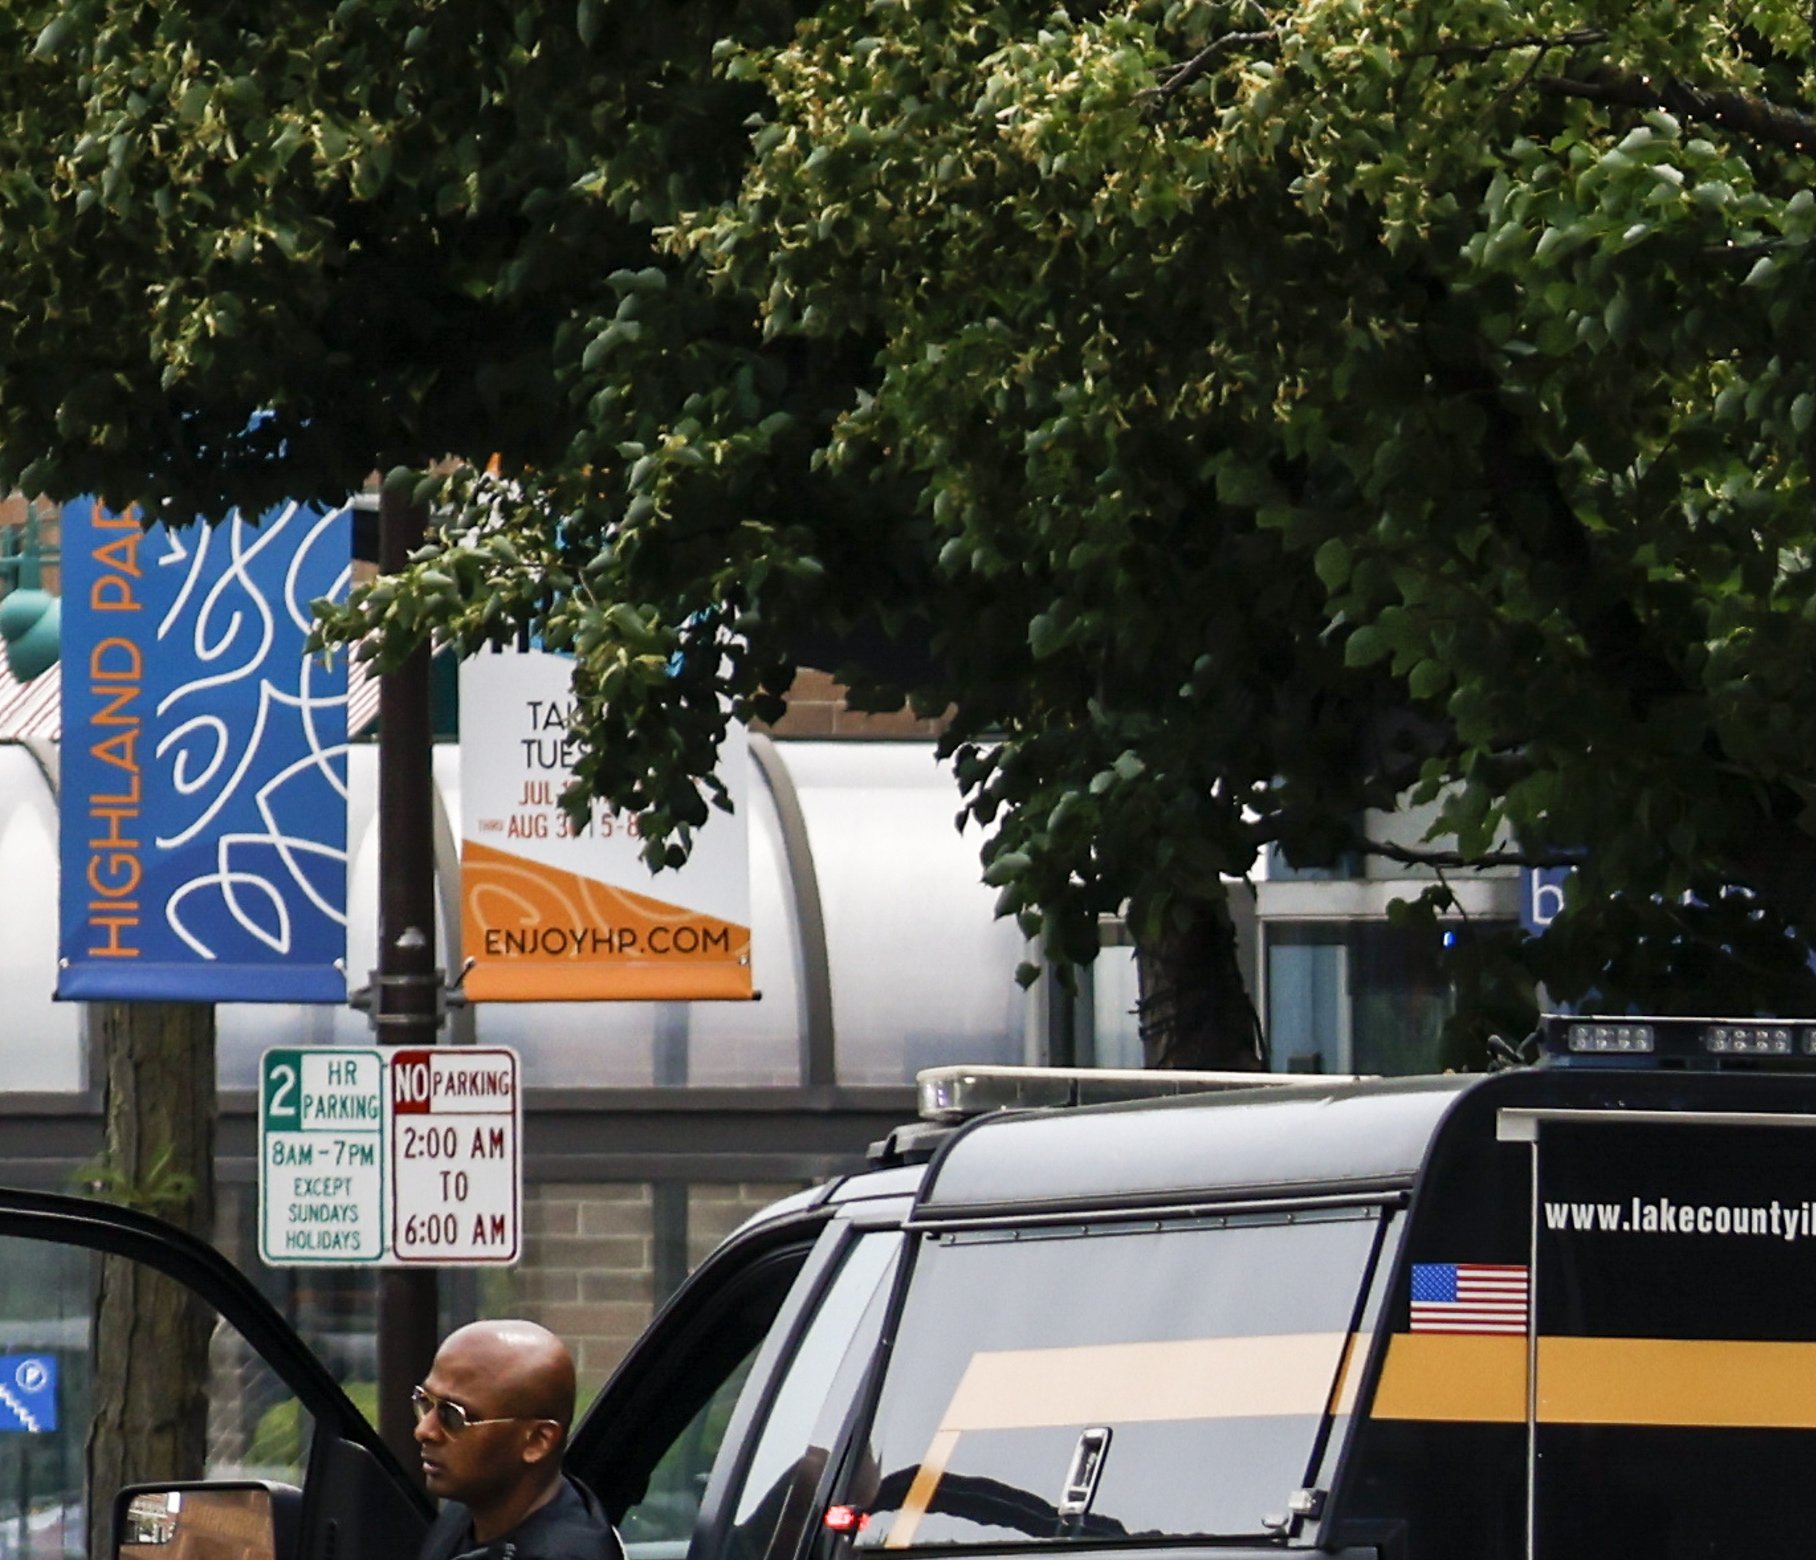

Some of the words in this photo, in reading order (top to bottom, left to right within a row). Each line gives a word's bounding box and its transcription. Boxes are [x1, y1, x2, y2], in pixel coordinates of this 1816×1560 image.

[87, 636, 142, 957] HIGHLAND
[518, 780, 553, 805] JUL
[507, 814, 547, 839] AUG
[484, 926, 730, 956] ENJOYHP.COM
[269, 1064, 296, 1117] 2
[328, 1061, 357, 1086] HR
[395, 1063, 429, 1103] NO
[433, 1071, 511, 1097] PARKING
[303, 1094, 379, 1121] PARKING
[403, 1127, 458, 1160] 2:00
[470, 1127, 504, 1159] AM
[294, 1177, 353, 1197] EXCEPT
[440, 1171, 469, 1202] TO
[288, 1203, 359, 1224] SUNDAYS
[286, 1230, 361, 1251] HOLIDAYS
[404, 1214, 459, 1246] 6:00
[472, 1214, 506, 1245] AM
